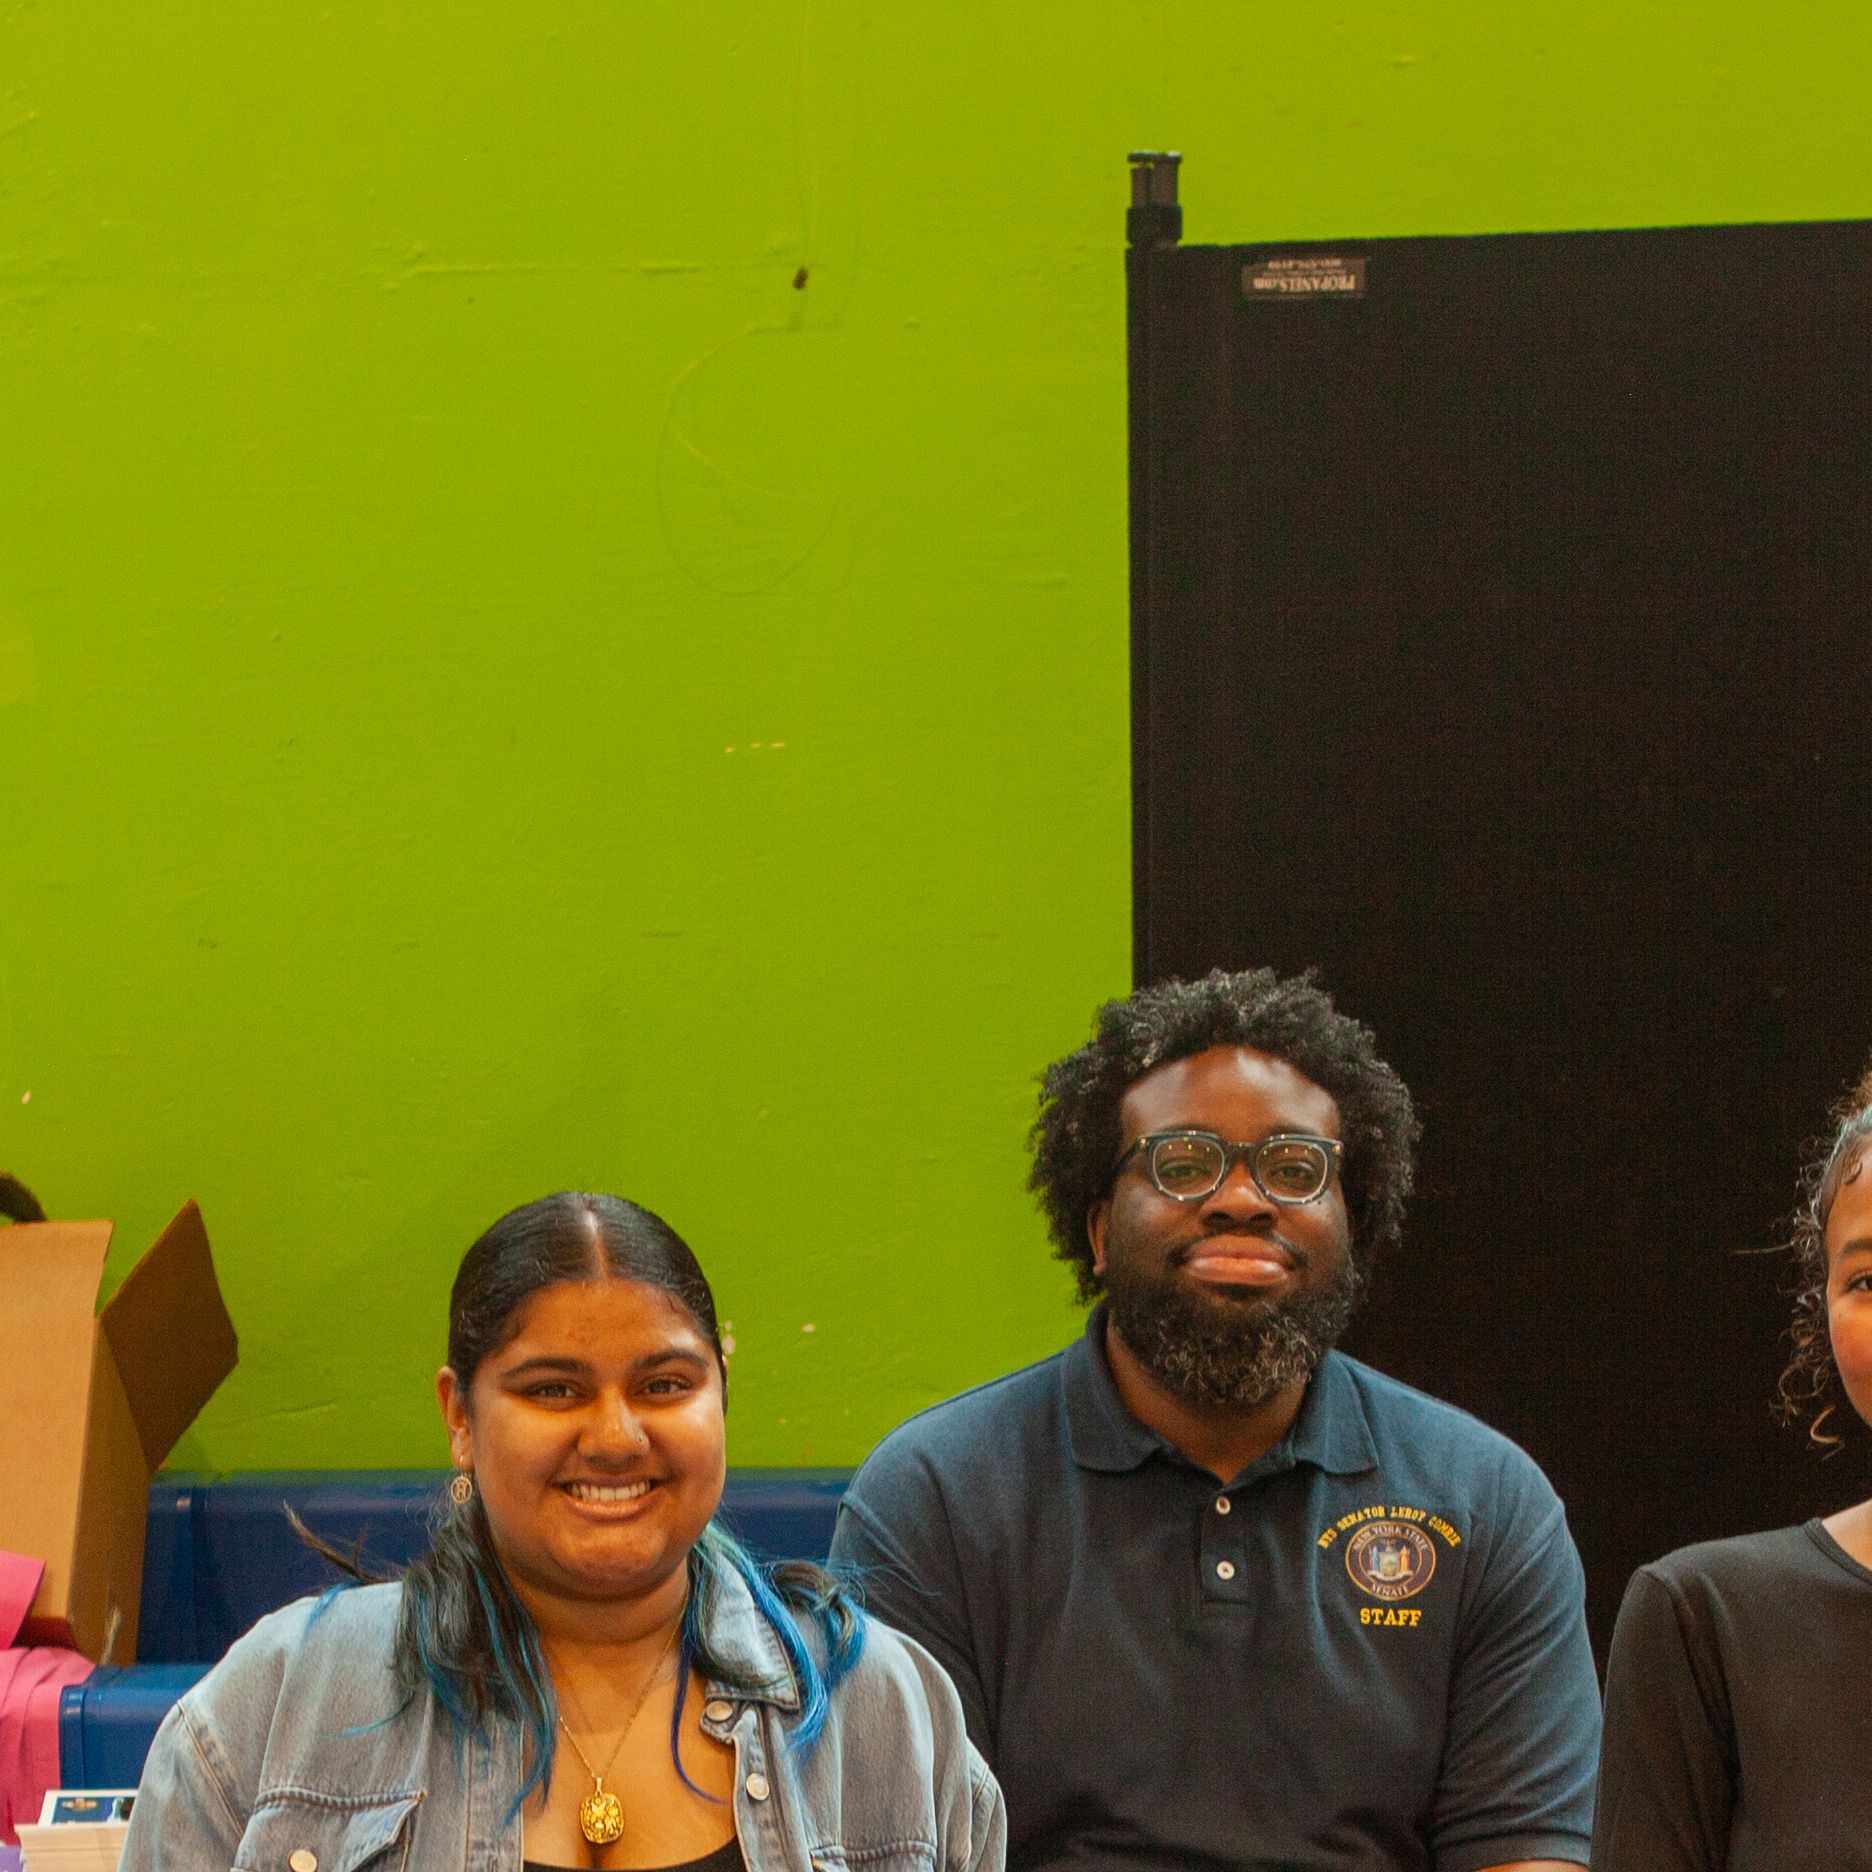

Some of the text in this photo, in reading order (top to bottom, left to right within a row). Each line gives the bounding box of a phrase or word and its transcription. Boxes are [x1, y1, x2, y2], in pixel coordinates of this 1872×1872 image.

[1336, 1504, 1385, 1531] SENATOR
[1390, 1505, 1426, 1522] LEROY
[1428, 1516, 1462, 1547] COMRIE
[1360, 1608, 1422, 1627] STAFF
